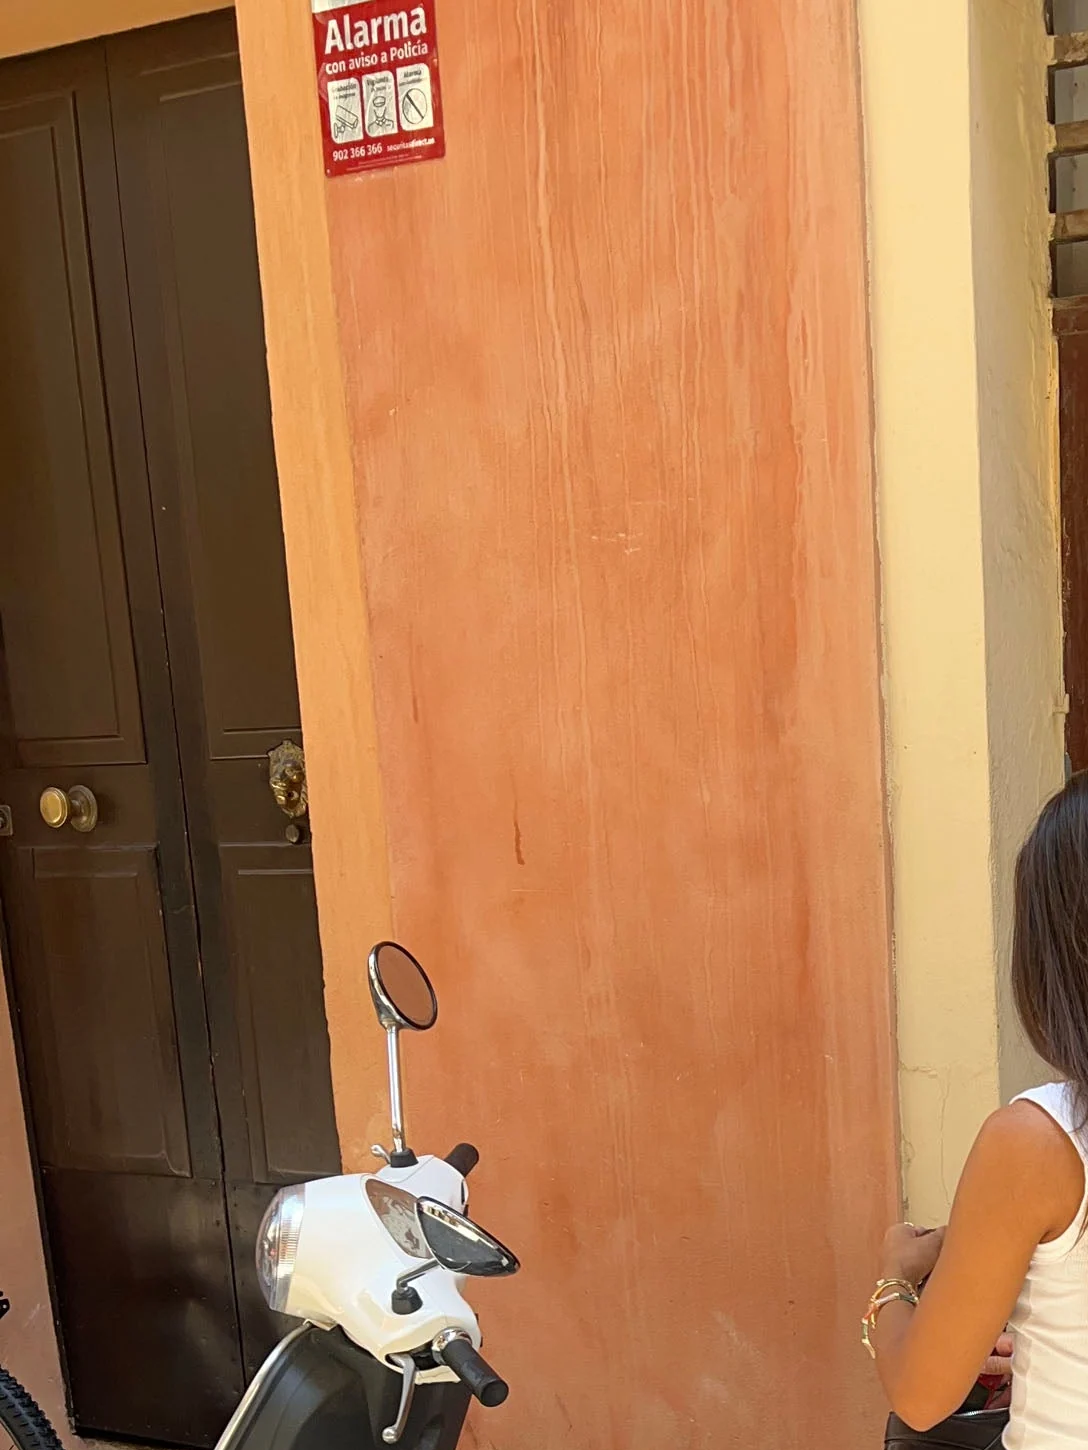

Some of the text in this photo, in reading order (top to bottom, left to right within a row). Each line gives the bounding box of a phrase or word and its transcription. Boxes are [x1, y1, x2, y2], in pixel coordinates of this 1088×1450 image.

[325, 6, 427, 55] Alarma
[325, 39, 428, 75] con aviso a Policía
[332, 148, 349, 162] 902
[350, 145, 366, 159] 366
[367, 142, 383, 156] 366
